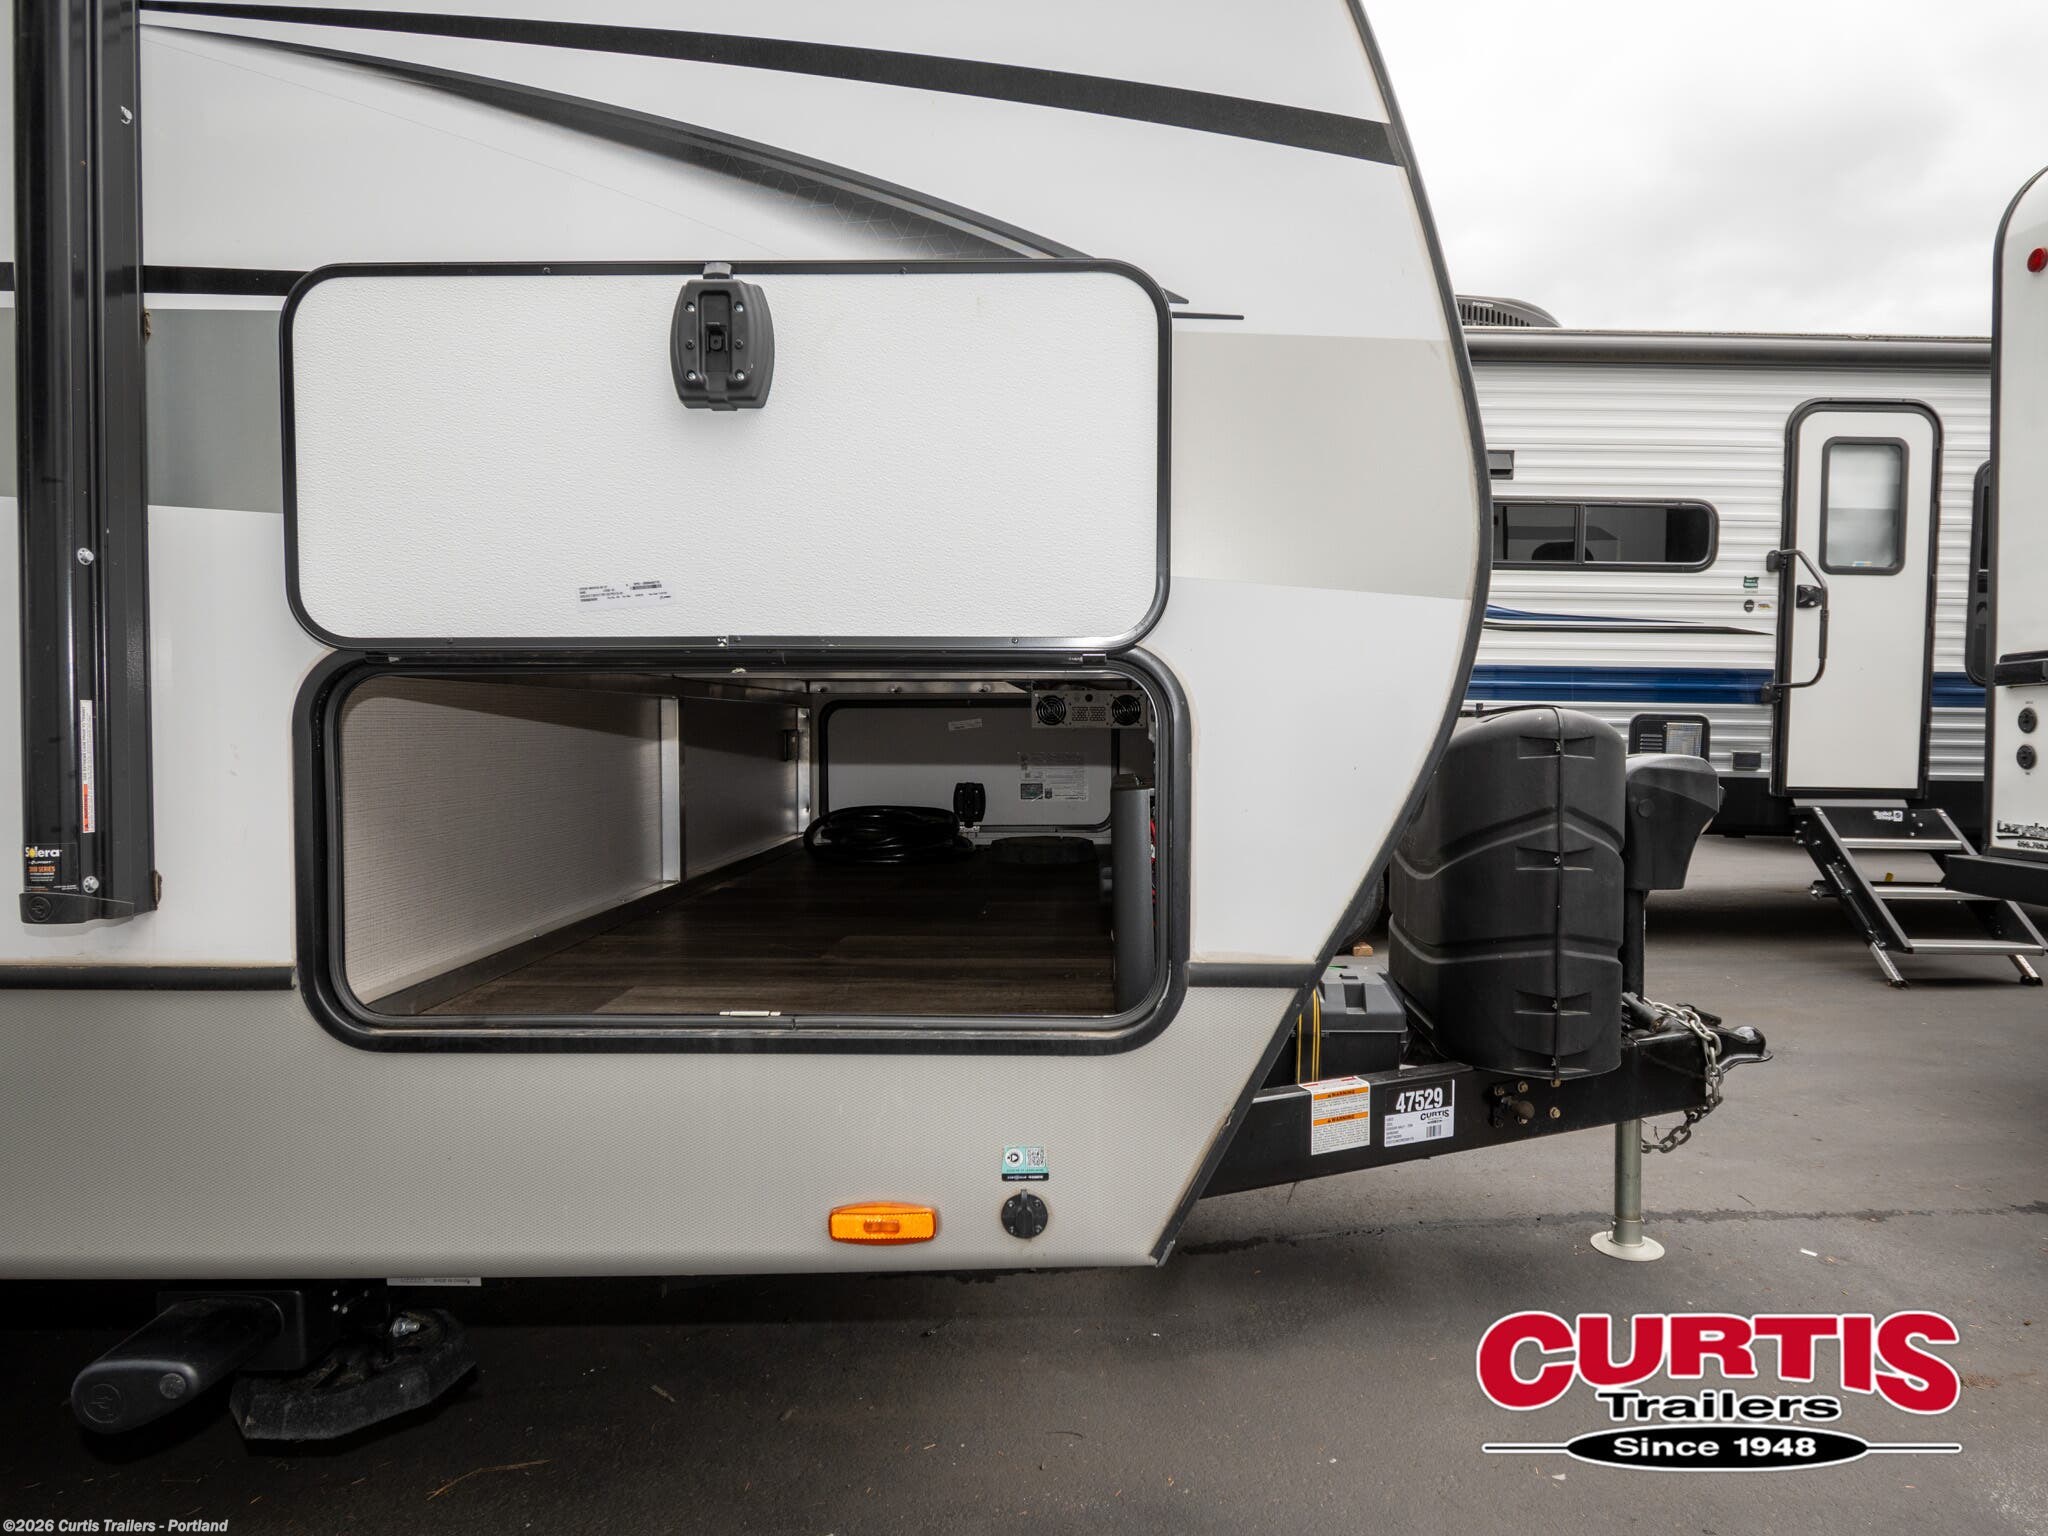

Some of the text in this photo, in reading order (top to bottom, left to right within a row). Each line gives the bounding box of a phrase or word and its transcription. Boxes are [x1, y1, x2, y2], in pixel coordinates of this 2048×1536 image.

[25, 846, 60, 858] Solera
[1395, 1087, 1443, 1113] 47529
[1420, 1110, 1450, 1121] CURTIS
